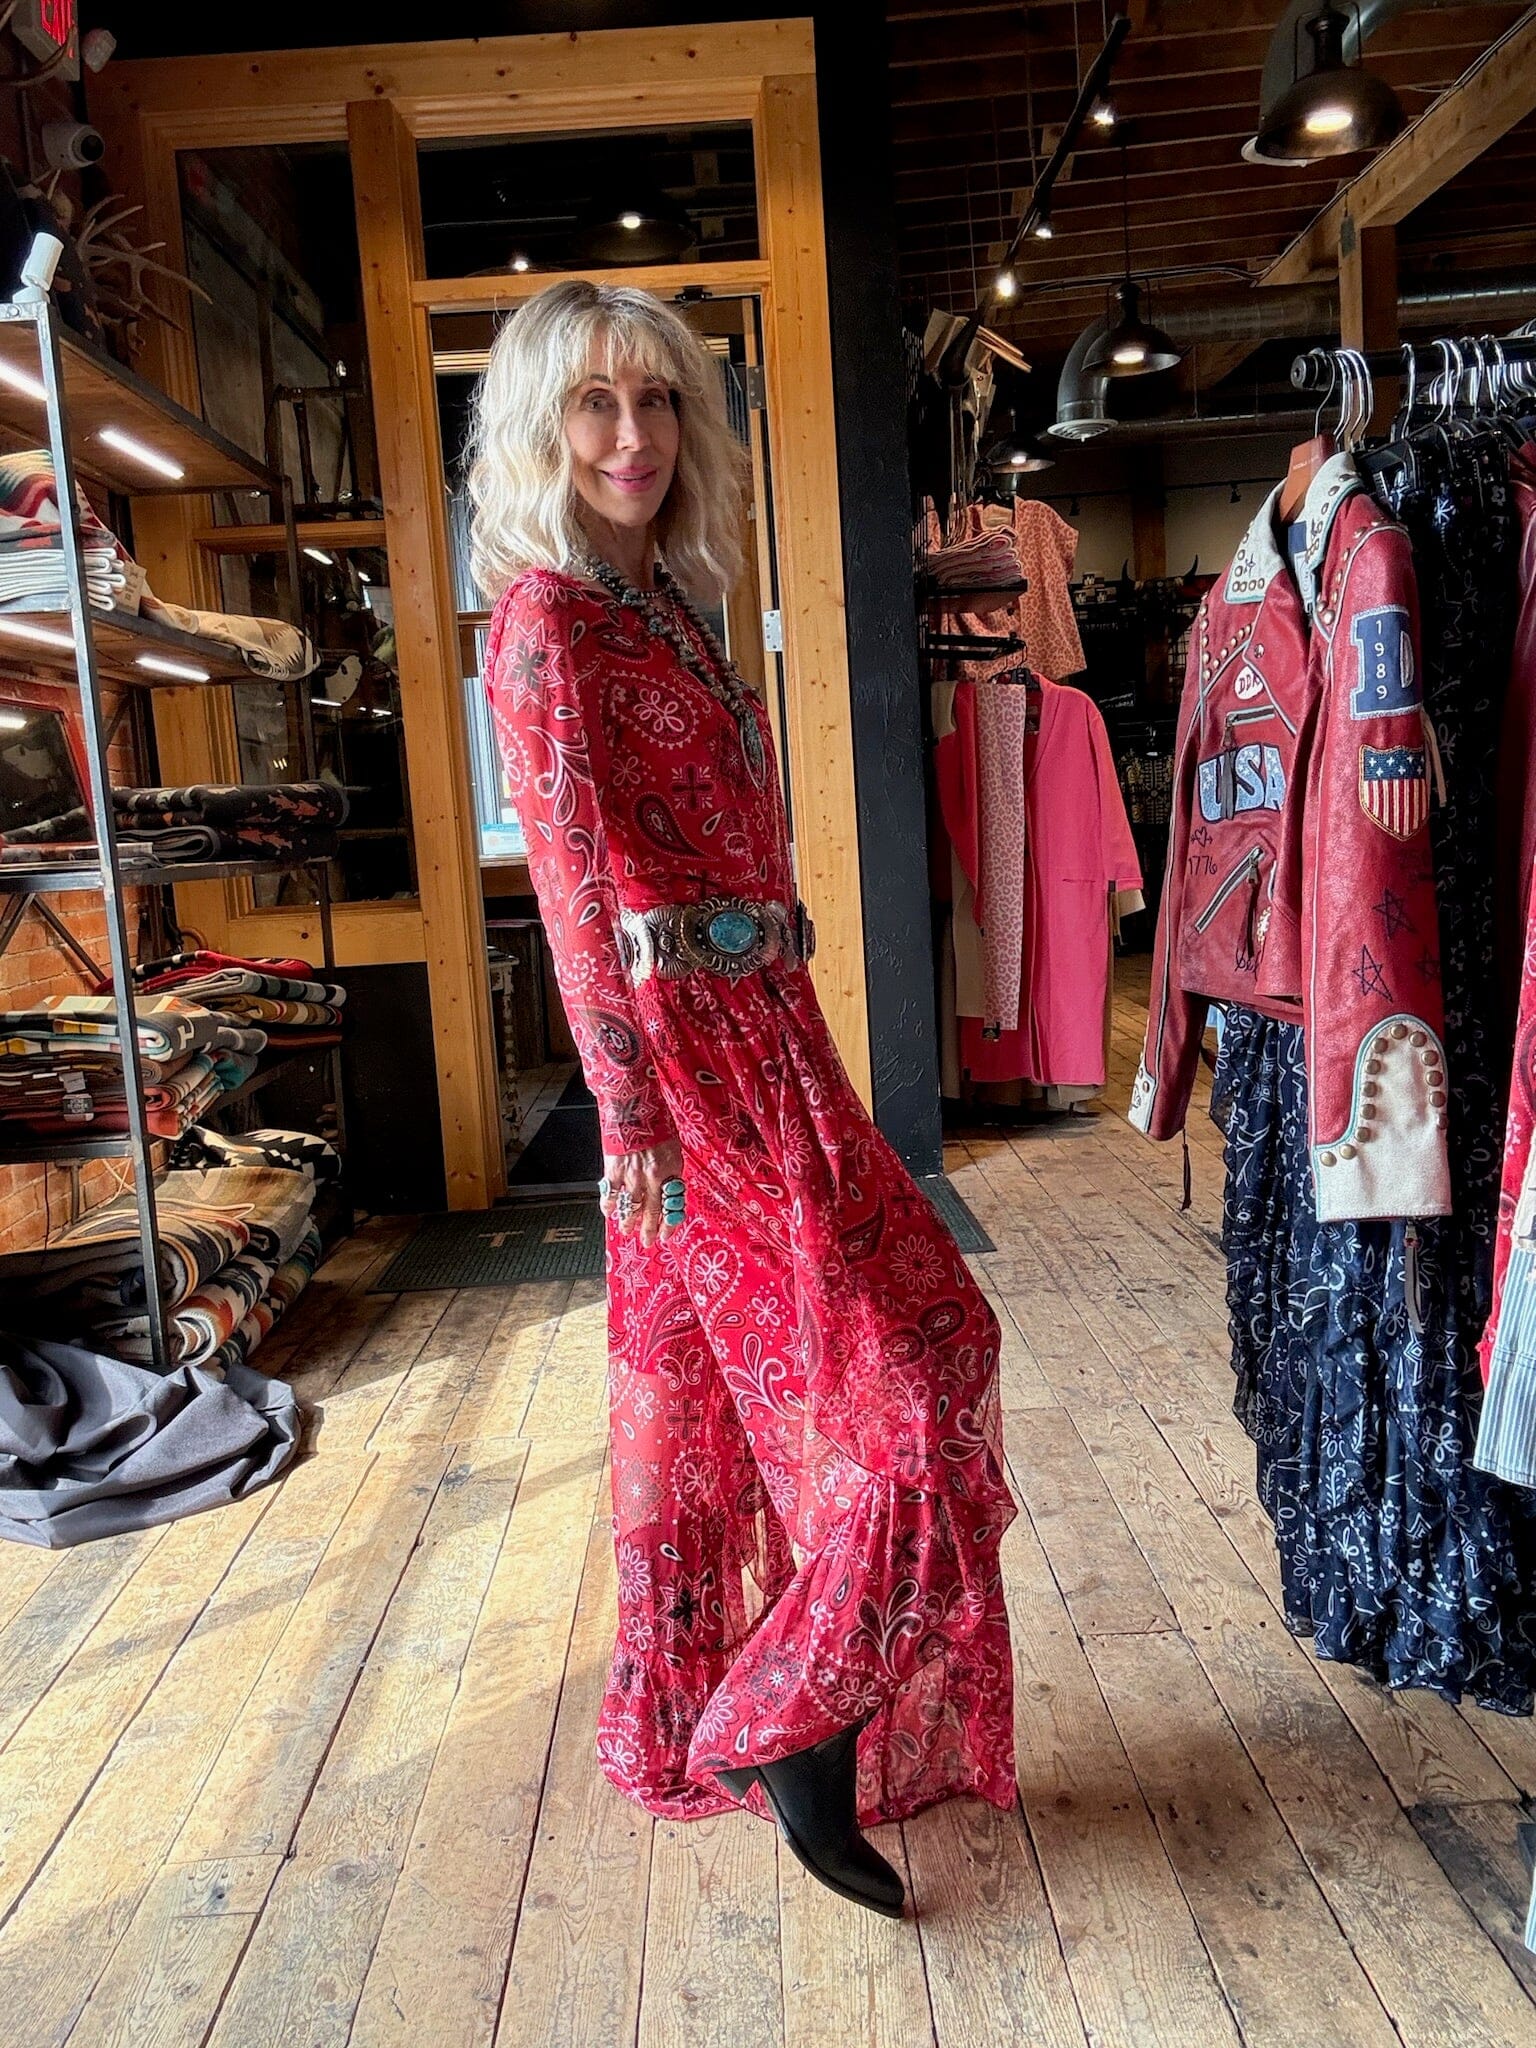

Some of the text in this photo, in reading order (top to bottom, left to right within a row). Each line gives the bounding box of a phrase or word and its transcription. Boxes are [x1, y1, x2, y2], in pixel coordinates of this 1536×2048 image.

[1374, 619, 1388, 700] 1989
[1198, 743, 1287, 823] USA
[1188, 855, 1218, 875] 1776
